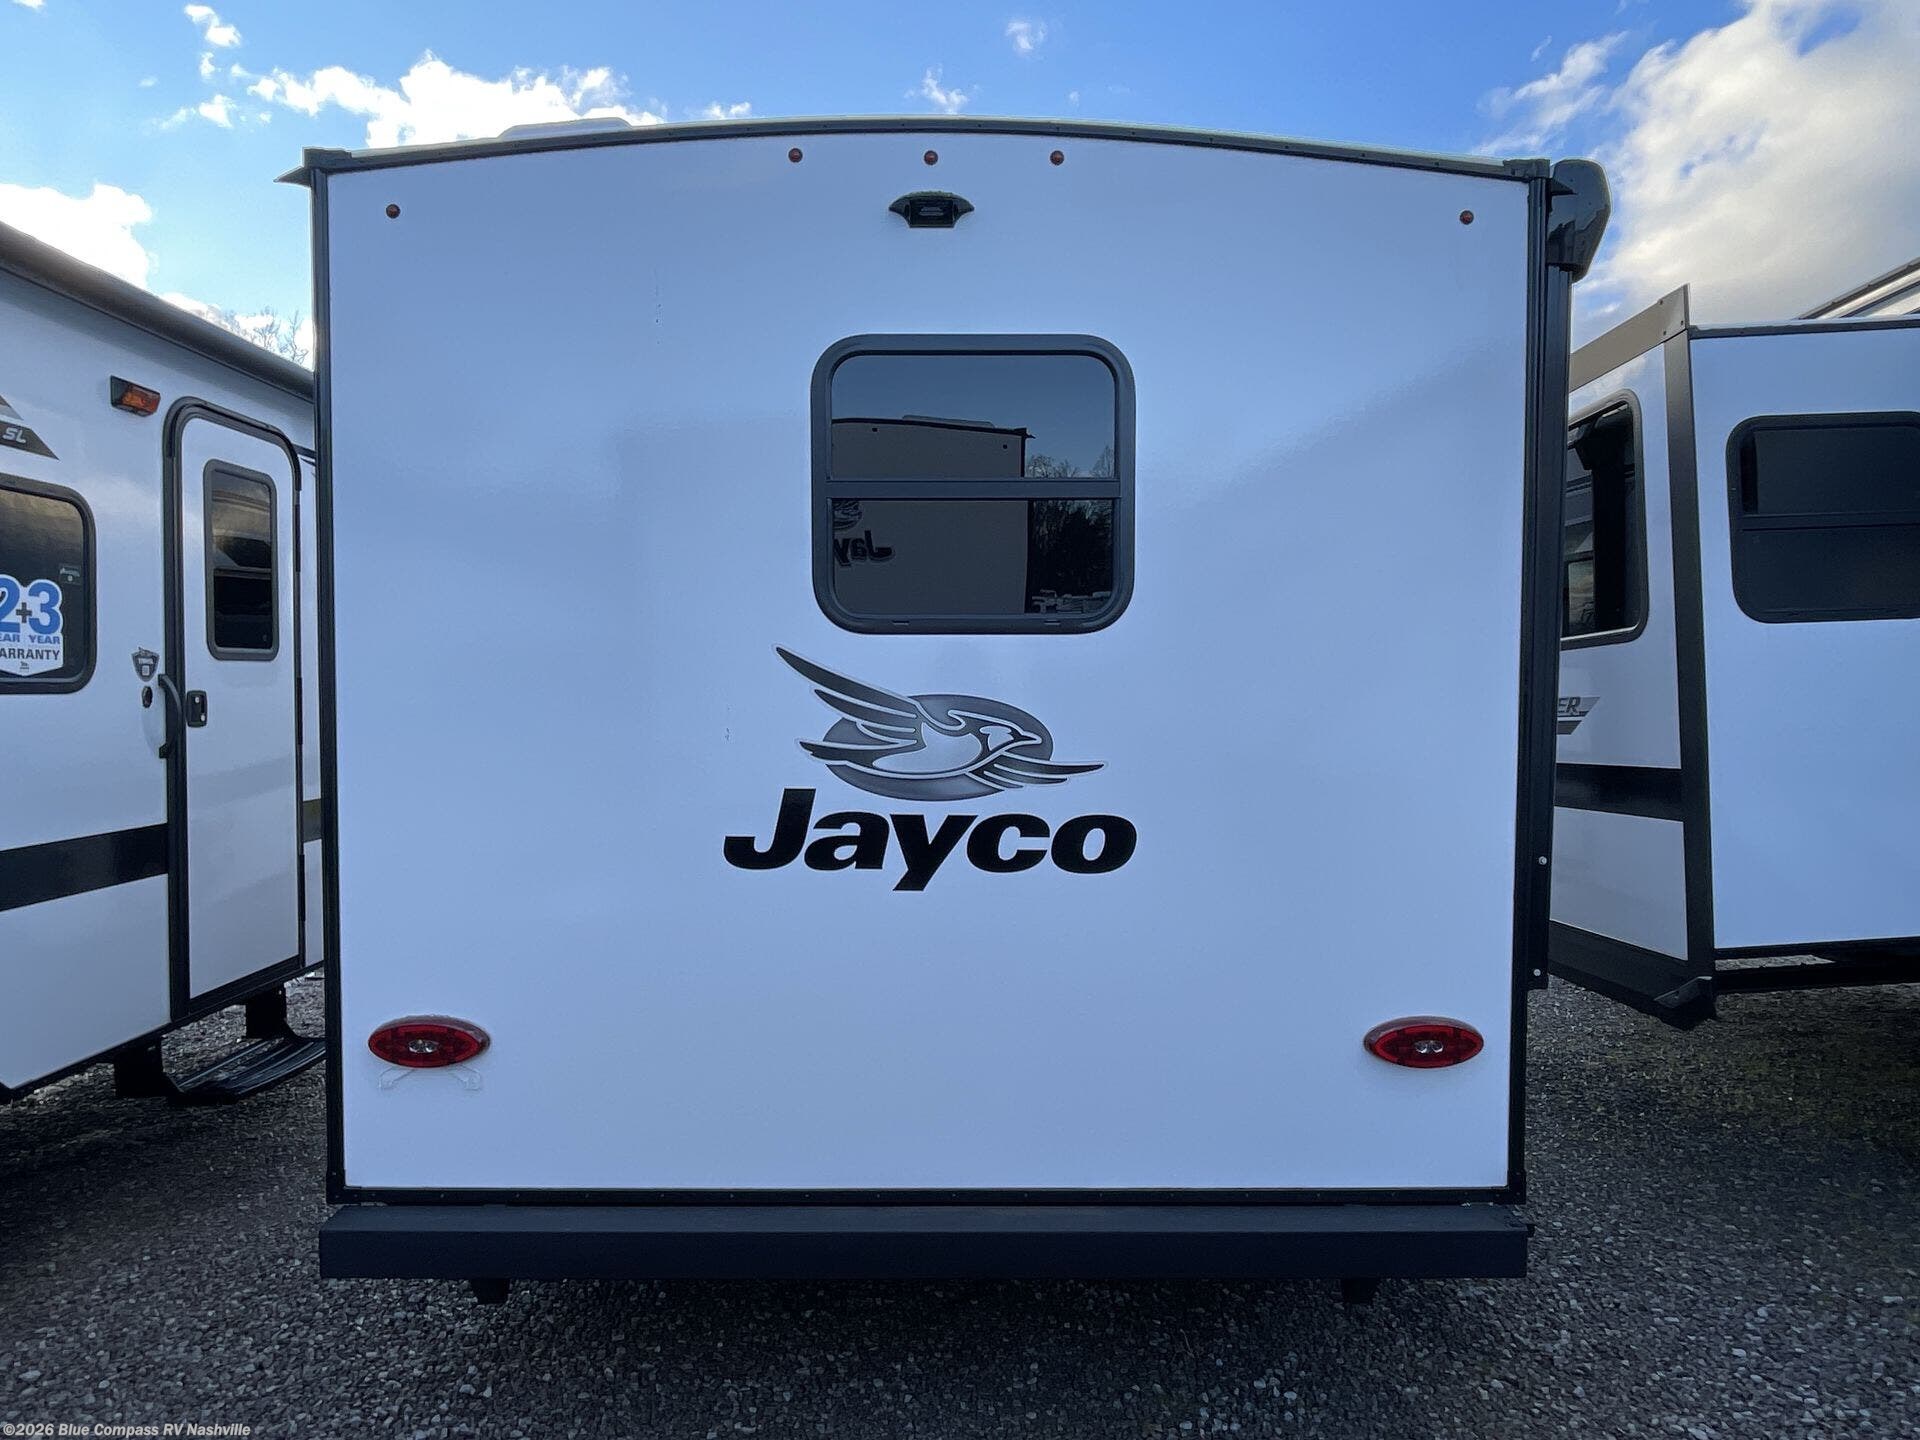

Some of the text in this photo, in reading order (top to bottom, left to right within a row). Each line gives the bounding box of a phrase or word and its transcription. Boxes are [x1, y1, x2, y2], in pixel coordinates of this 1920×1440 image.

[2, 427, 26, 443] SL
[29, 635, 60, 644] YEAR
[723, 788, 1137, 891] Jayco
